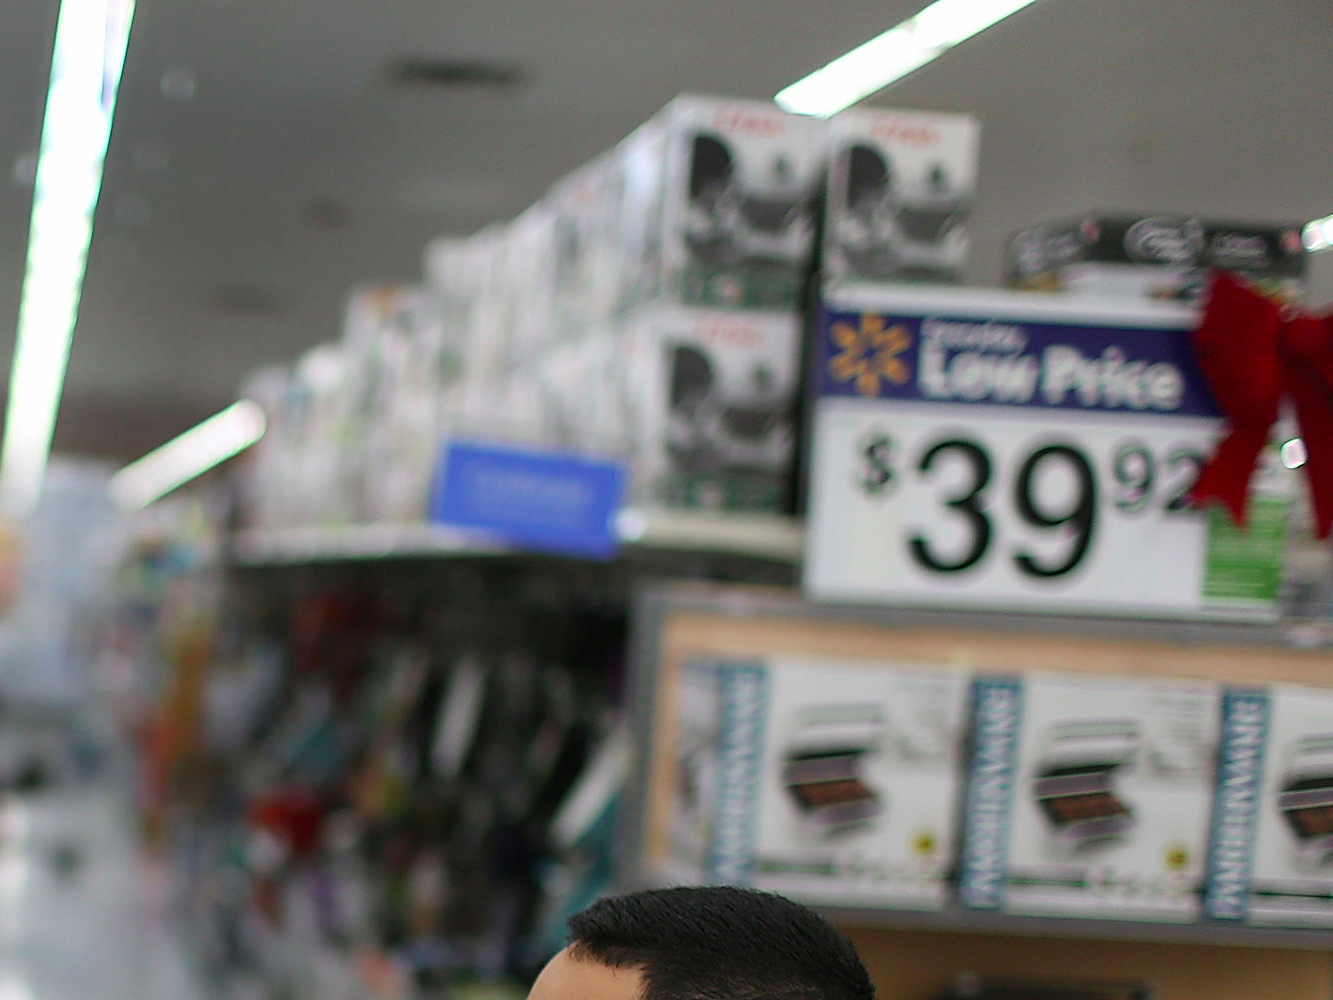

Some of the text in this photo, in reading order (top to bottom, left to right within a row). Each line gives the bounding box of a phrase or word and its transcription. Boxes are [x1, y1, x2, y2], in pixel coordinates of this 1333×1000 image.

[918, 344, 1184, 410] Low Price
[908, 438, 1097, 579] 39
